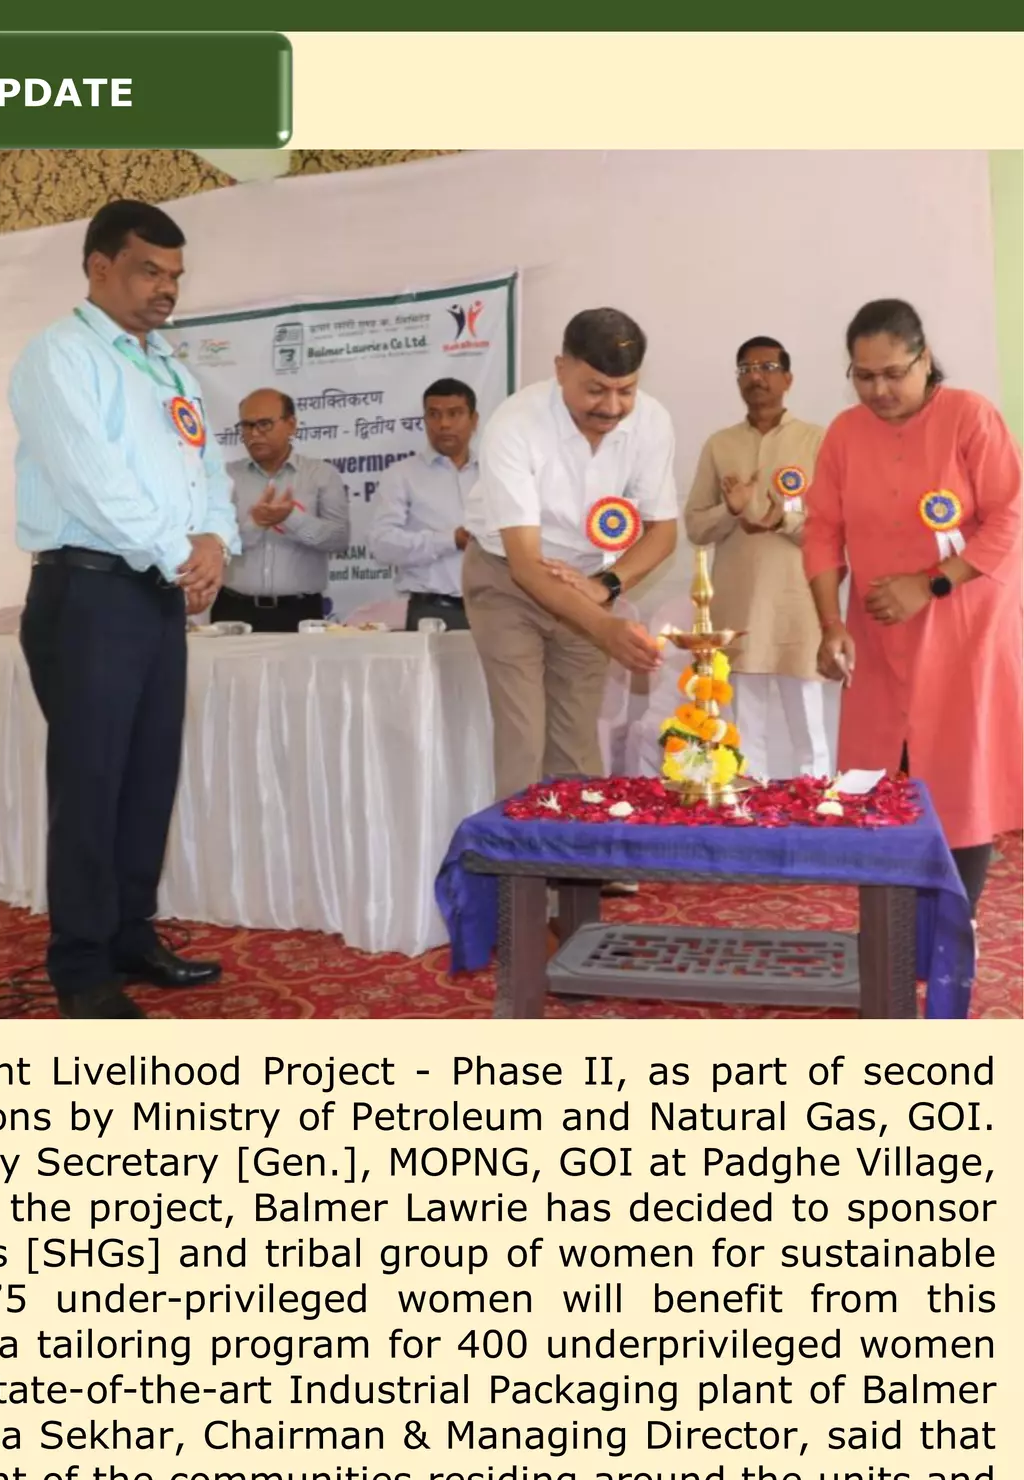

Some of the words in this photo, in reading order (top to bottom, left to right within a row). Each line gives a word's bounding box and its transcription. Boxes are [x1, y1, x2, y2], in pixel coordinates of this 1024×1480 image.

[307, 346, 345, 359] Balmer
[296, 388, 386, 412] सशक्तिकरण
[355, 415, 397, 440] द्वितीय
[401, 416, 425, 431] चर
[329, 565, 349, 581] and
[351, 565, 393, 581] Natural
[54, 1055, 239, 1085] Livelihood
[266, 1057, 394, 1092] Project
[454, 1056, 562, 1085] Phase
[585, 1057, 625, 1091] II,
[649, 1063, 689, 1085] as
[713, 1058, 786, 1092] part
[809, 1055, 845, 1085] of
[865, 1056, 993, 1085] second
[38, 1147, 218, 1183] Secretary
[239, 1147, 369, 1183] [Gen.],
[391, 1147, 540, 1183] MOPNG,
[560, 1147, 632, 1176] GOI
[650, 1149, 686, 1176] at
[705, 1147, 839, 1183] Padghe
[857, 1146, 993, 1183] Village,
[11, 1192, 70, 1222] the
[91, 1193, 233, 1229] project,
[256, 1192, 388, 1222] Balmer
[408, 1193, 527, 1222] Lawrie
[548, 1192, 610, 1222] has
[630, 1192, 771, 1222] decided
[792, 1194, 828, 1222] to
[848, 1200, 997, 1229] sponsor
[41, 1420, 183, 1456] Sekhar,
[205, 1420, 383, 1449] Chairman
[404, 1420, 430, 1449] &
[448, 1421, 625, 1457] Managing
[648, 1421, 807, 1456] Director,
[829, 1420, 900, 1449] said
[920, 1420, 995, 1449] that
